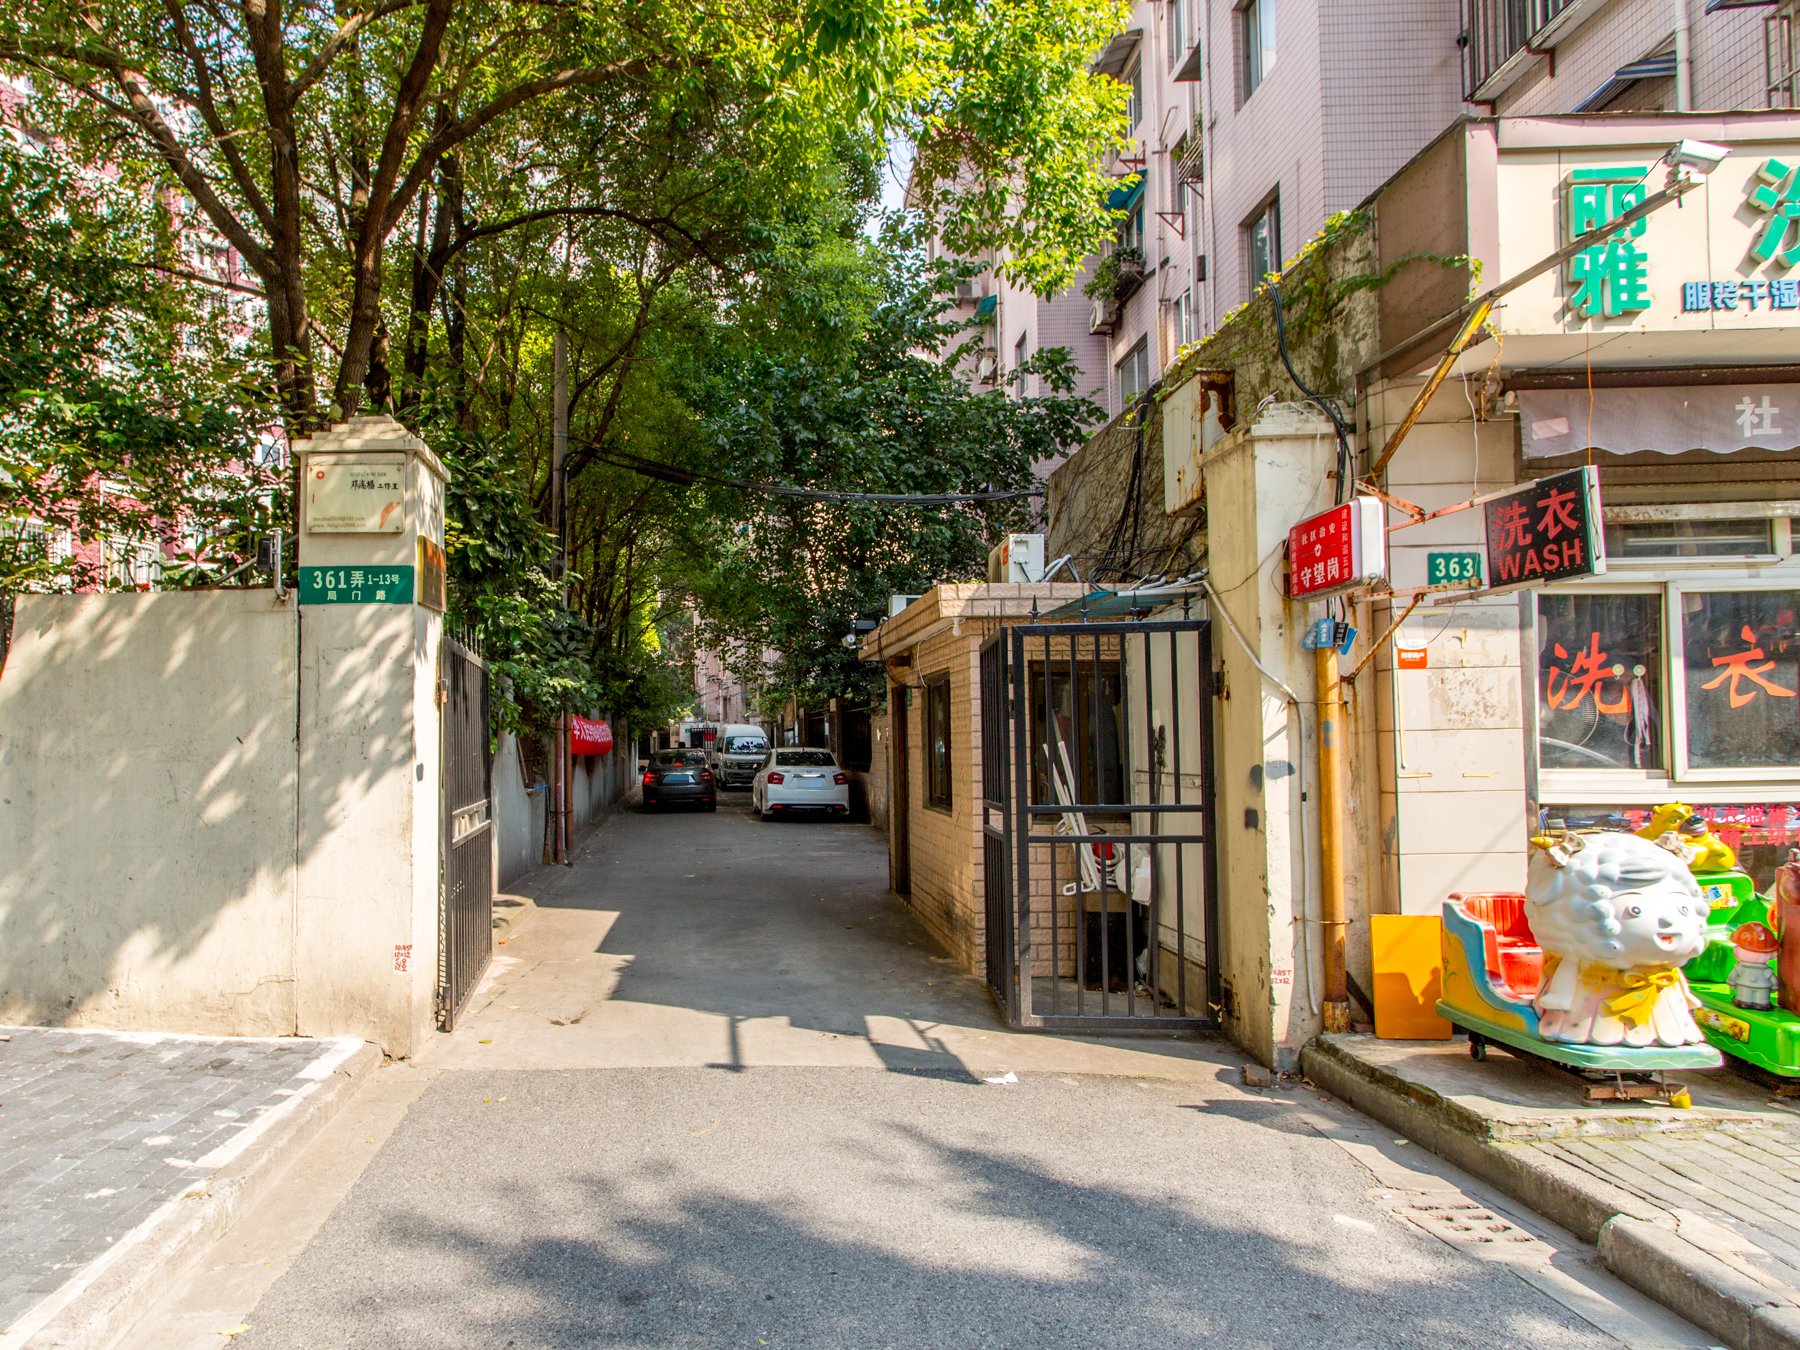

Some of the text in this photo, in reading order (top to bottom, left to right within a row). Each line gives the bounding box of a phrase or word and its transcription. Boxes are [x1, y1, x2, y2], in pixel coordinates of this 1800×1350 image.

[1735, 396, 1782, 438] 社
[1301, 522, 1336, 546] 社区治安
[1494, 488, 1580, 551] 洗衣
[1300, 556, 1340, 588] 守望岗
[1435, 557, 1475, 578] 363
[1497, 538, 1583, 580] WASH
[327, 590, 386, 601] 局门路
